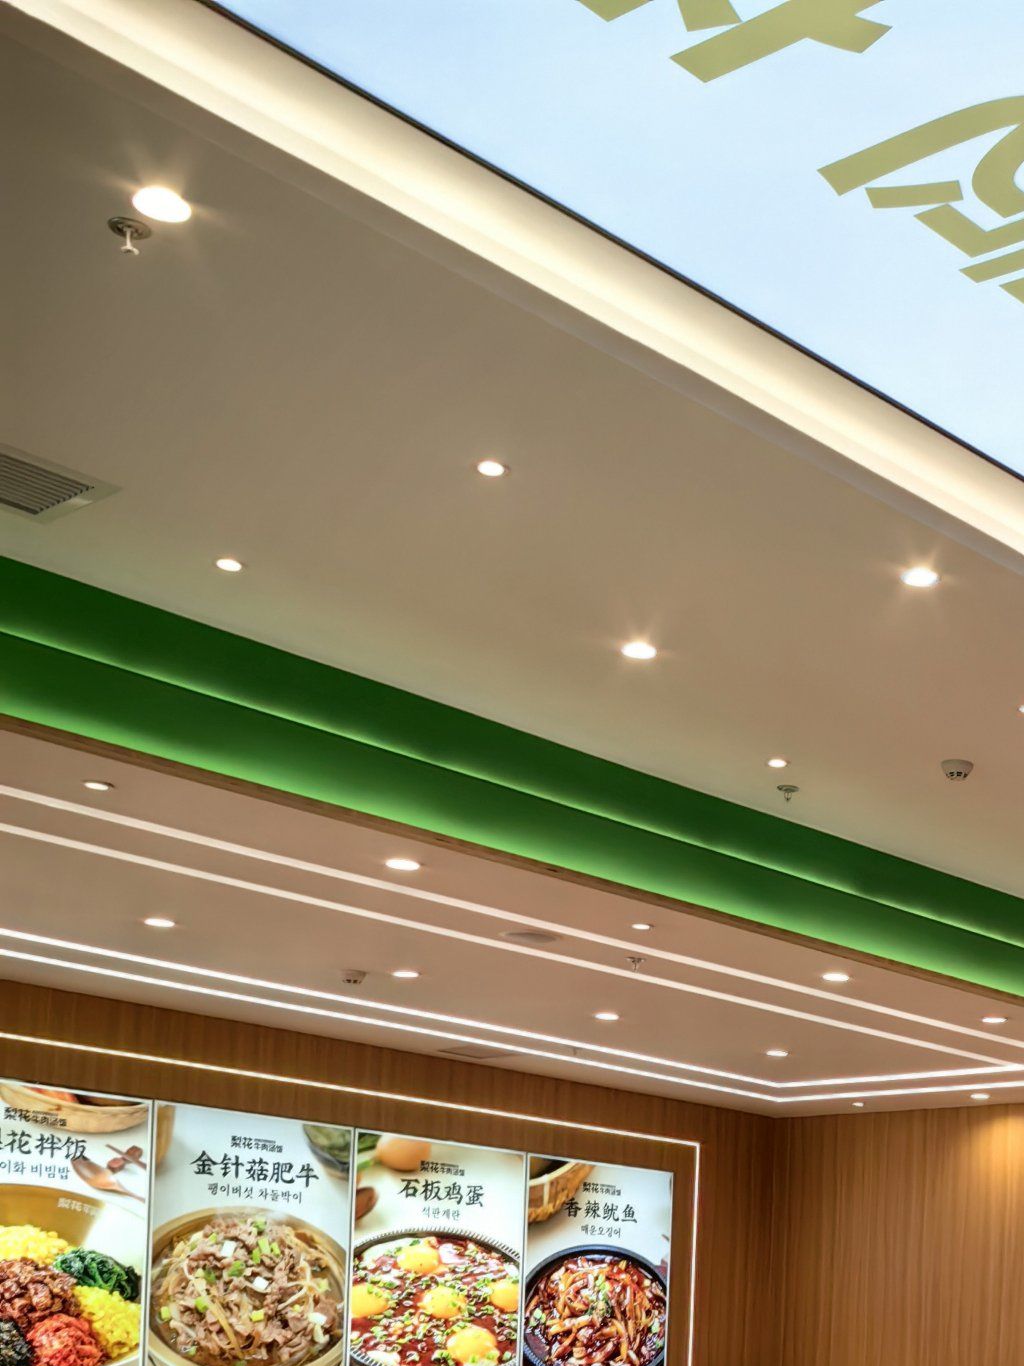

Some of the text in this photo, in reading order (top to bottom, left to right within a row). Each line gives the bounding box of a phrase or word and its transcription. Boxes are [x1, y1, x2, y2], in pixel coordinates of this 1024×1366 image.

[0, 1127, 88, 1161] 花拌饭
[30, 1163, 70, 1180] 비빔밥
[190, 1150, 319, 1188] 金针菇肥牛
[397, 1178, 484, 1207] 石板鸡蛋
[564, 1197, 638, 1223] 香辣鱿鱼
